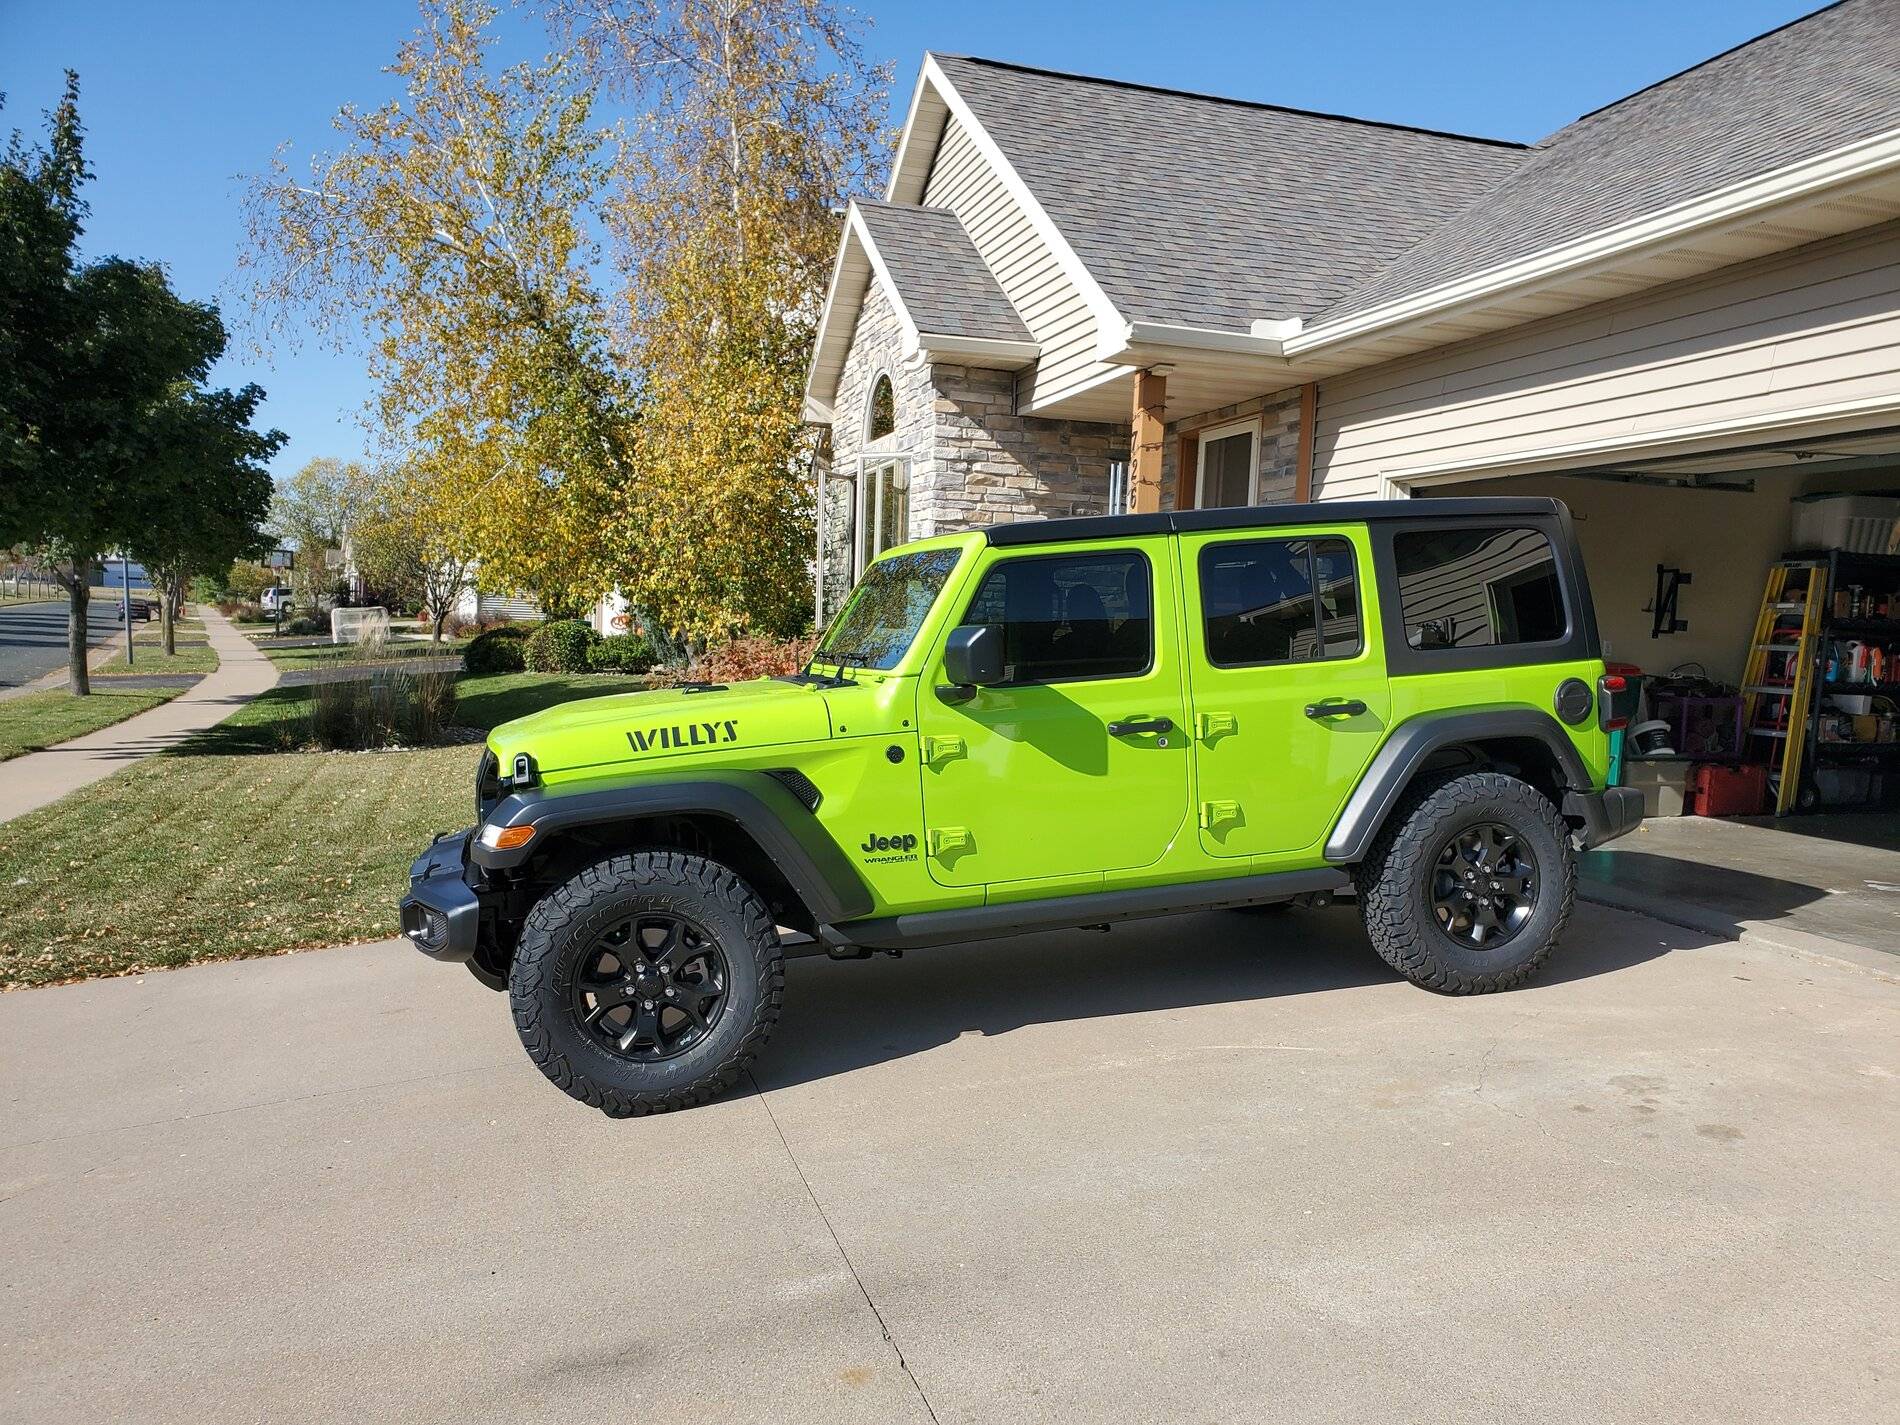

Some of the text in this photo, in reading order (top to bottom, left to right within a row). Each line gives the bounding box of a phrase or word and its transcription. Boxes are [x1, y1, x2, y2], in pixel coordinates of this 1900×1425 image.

[626, 719, 738, 752] WILLYS
[861, 833, 917, 852] Jeep
[864, 854, 918, 864] WRANGLER
